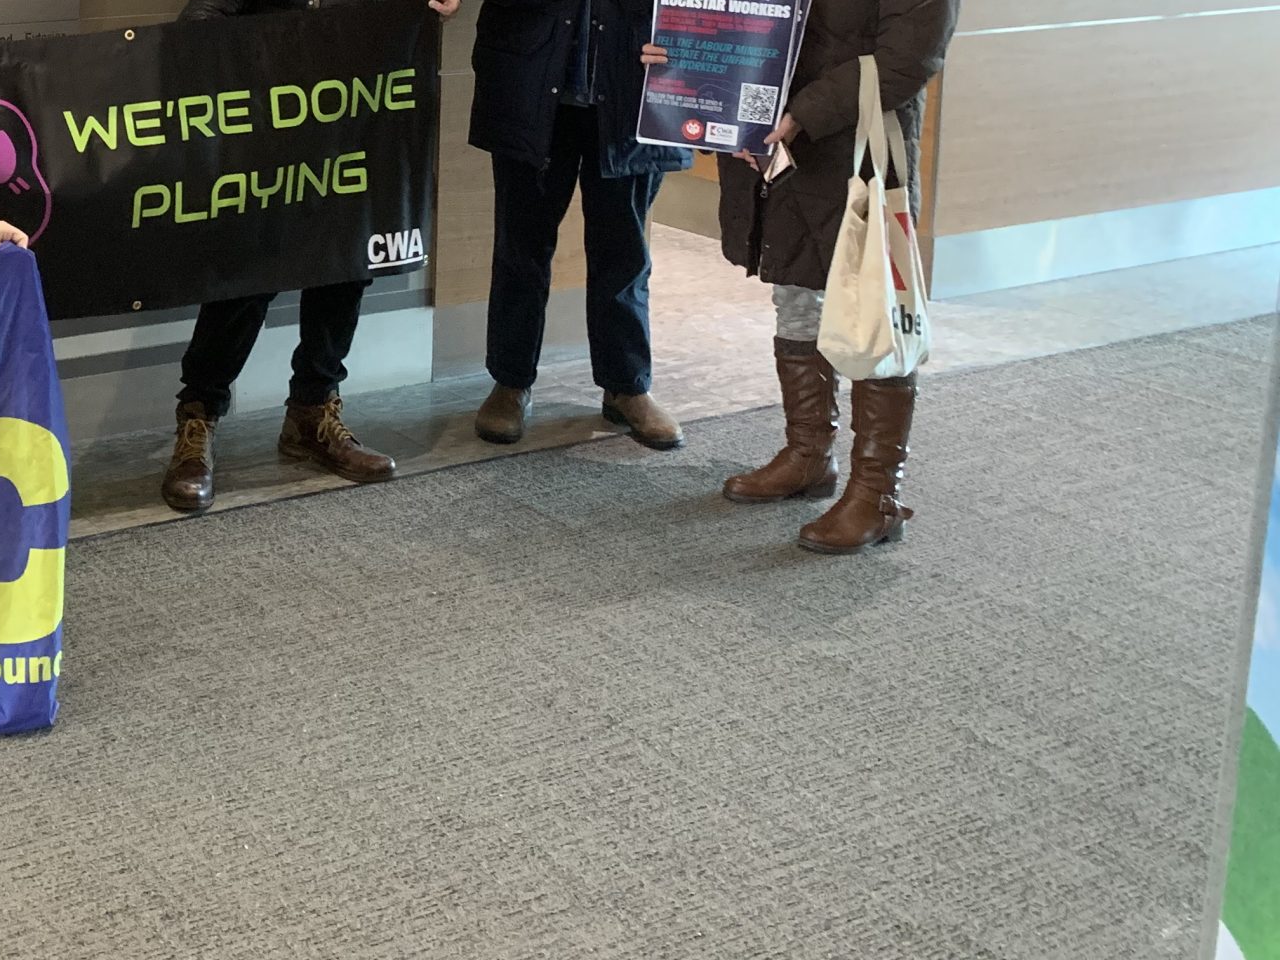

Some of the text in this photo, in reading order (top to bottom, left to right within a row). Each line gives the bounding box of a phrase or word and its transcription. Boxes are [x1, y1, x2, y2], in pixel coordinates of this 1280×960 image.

[728, 0, 791, 18] WORKERS
[656, 36, 673, 46] TELL
[677, 37, 695, 48] THE
[696, 39, 732, 52] LABOUR
[702, 51, 718, 62] THE
[63, 68, 416, 153] WE'RE DONE
[131, 151, 368, 229] PLAYING
[367, 228, 424, 264] CWA
